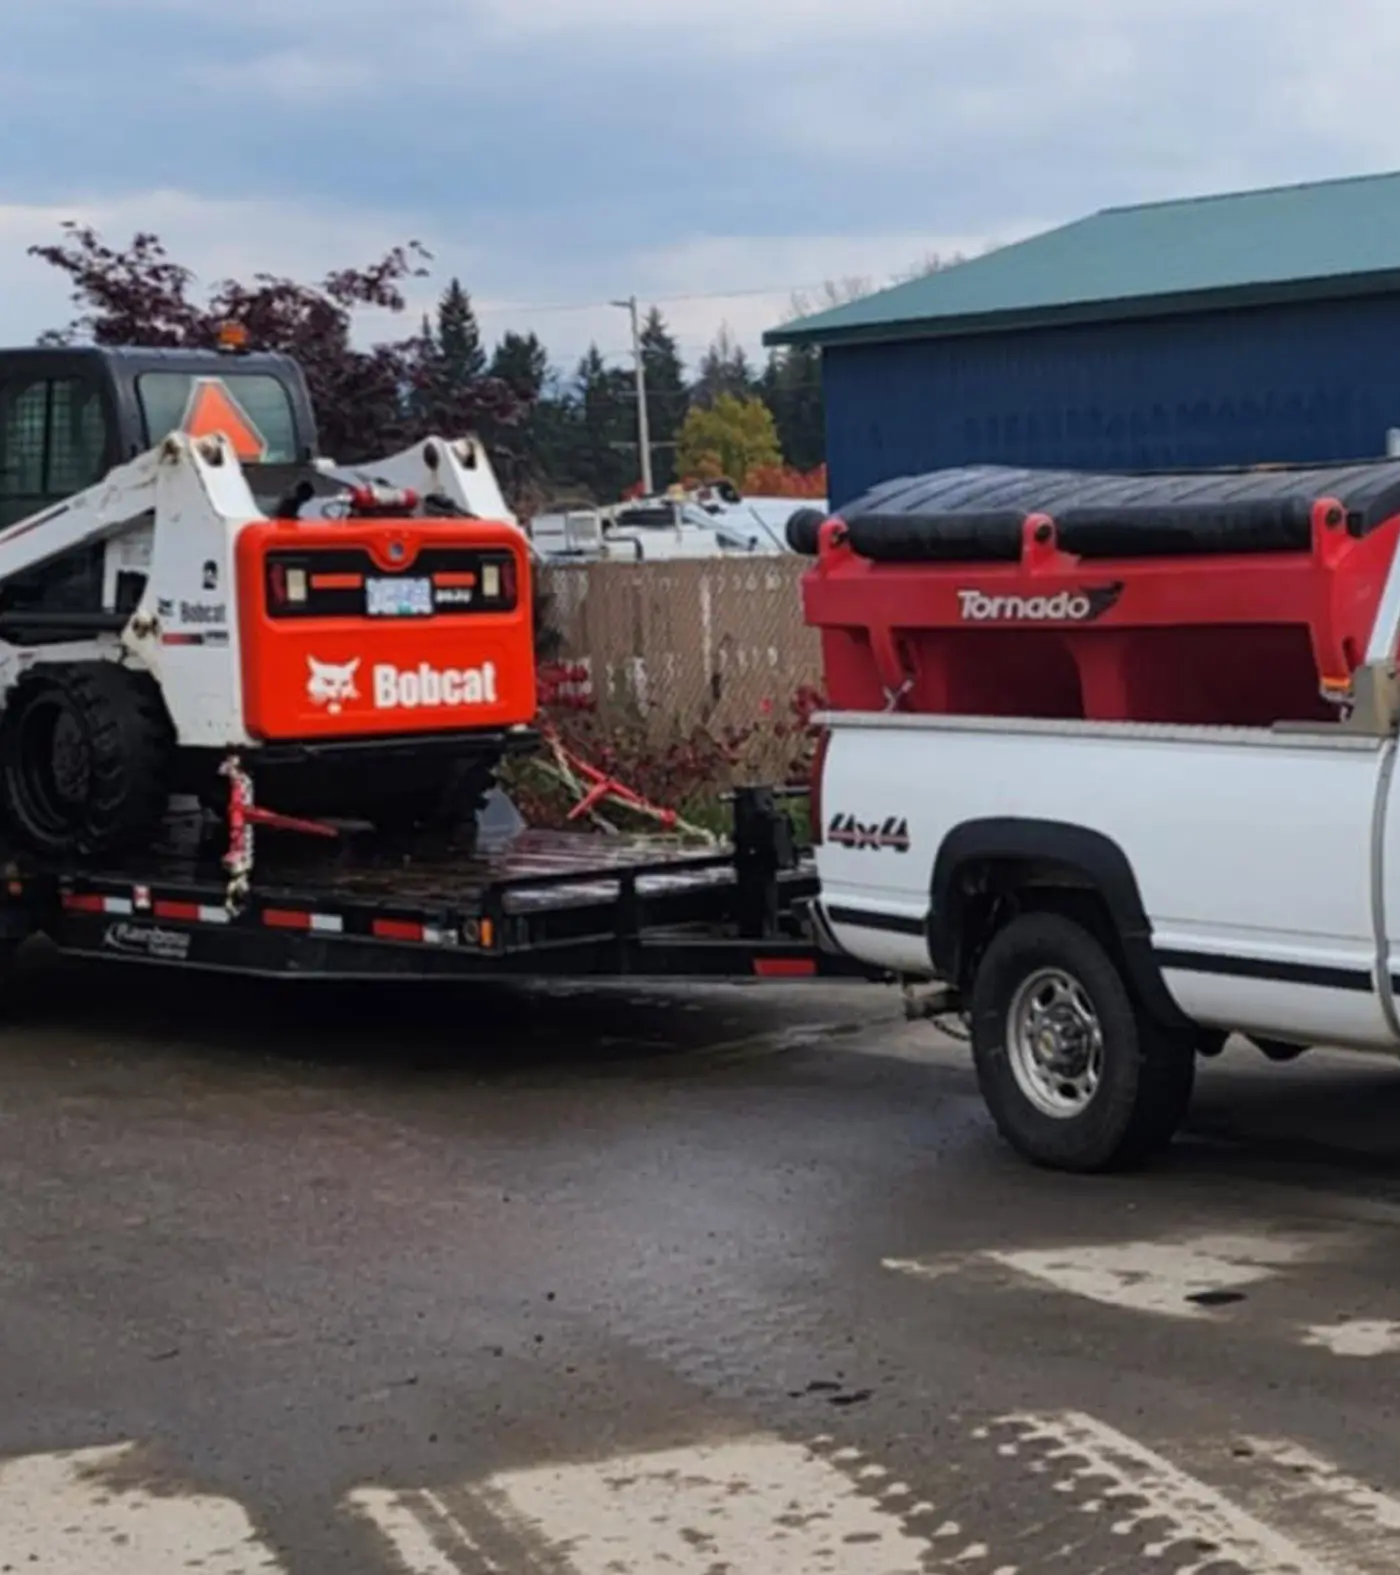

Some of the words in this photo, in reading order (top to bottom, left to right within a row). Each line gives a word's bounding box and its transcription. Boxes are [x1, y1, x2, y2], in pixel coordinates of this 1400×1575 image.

[957, 589, 1090, 620] Tornado
[373, 661, 497, 709] Bobcat
[828, 813, 910, 853] 4x4
